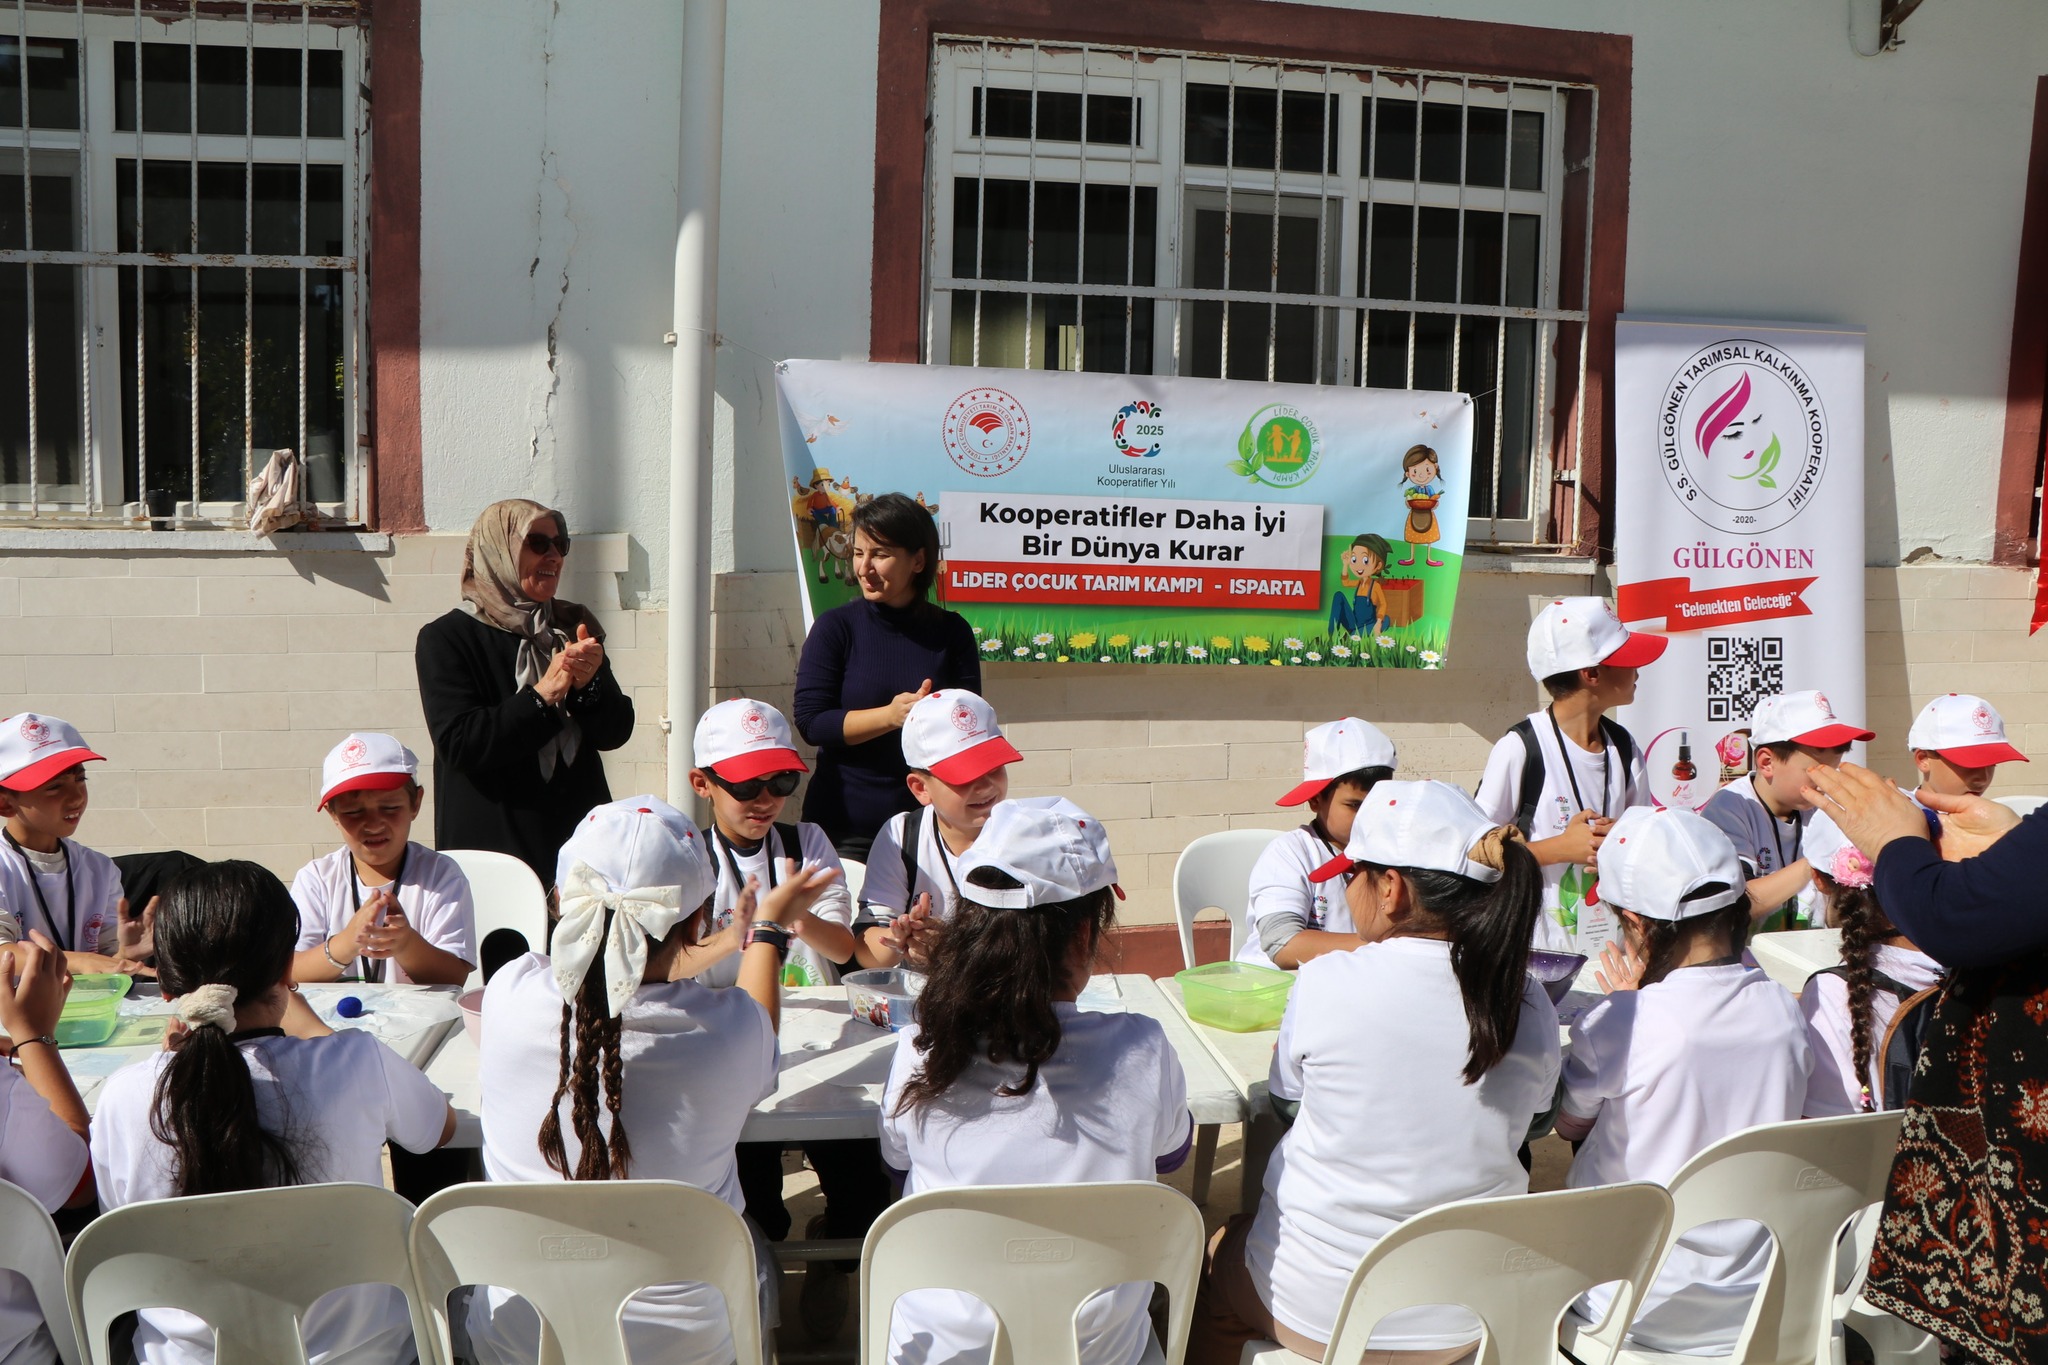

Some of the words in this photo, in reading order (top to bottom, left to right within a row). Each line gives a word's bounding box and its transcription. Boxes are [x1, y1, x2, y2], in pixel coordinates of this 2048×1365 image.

[1136, 425, 1164, 436] 2025
[1663, 381, 1688, 470] GÜLGÖNEN
[1684, 347, 1751, 381] TARIMSAL
[1754, 349, 1814, 407] KALKINMA
[1787, 409, 1823, 510] KOOPERATİFİ
[1097, 476, 1158, 488] Kooperatifler
[1160, 479, 1176, 488] Yılı
[1108, 464, 1165, 475] Uluslararası
[980, 502, 1167, 529] Kooperatifler
[1175, 509, 1245, 531] Daha
[1254, 505, 1286, 537] İyi
[1022, 533, 1062, 556] Bir
[1071, 536, 1160, 564] Dünya
[1169, 539, 1245, 561] Kurar
[1673, 541, 1814, 569] GÜLGÖNEN
[1011, 572, 1078, 592] ÇOCUK
[1082, 575, 1140, 592] TARIM
[1144, 576, 1203, 593] KAMPI
[1230, 578, 1306, 596] ISPARTA
